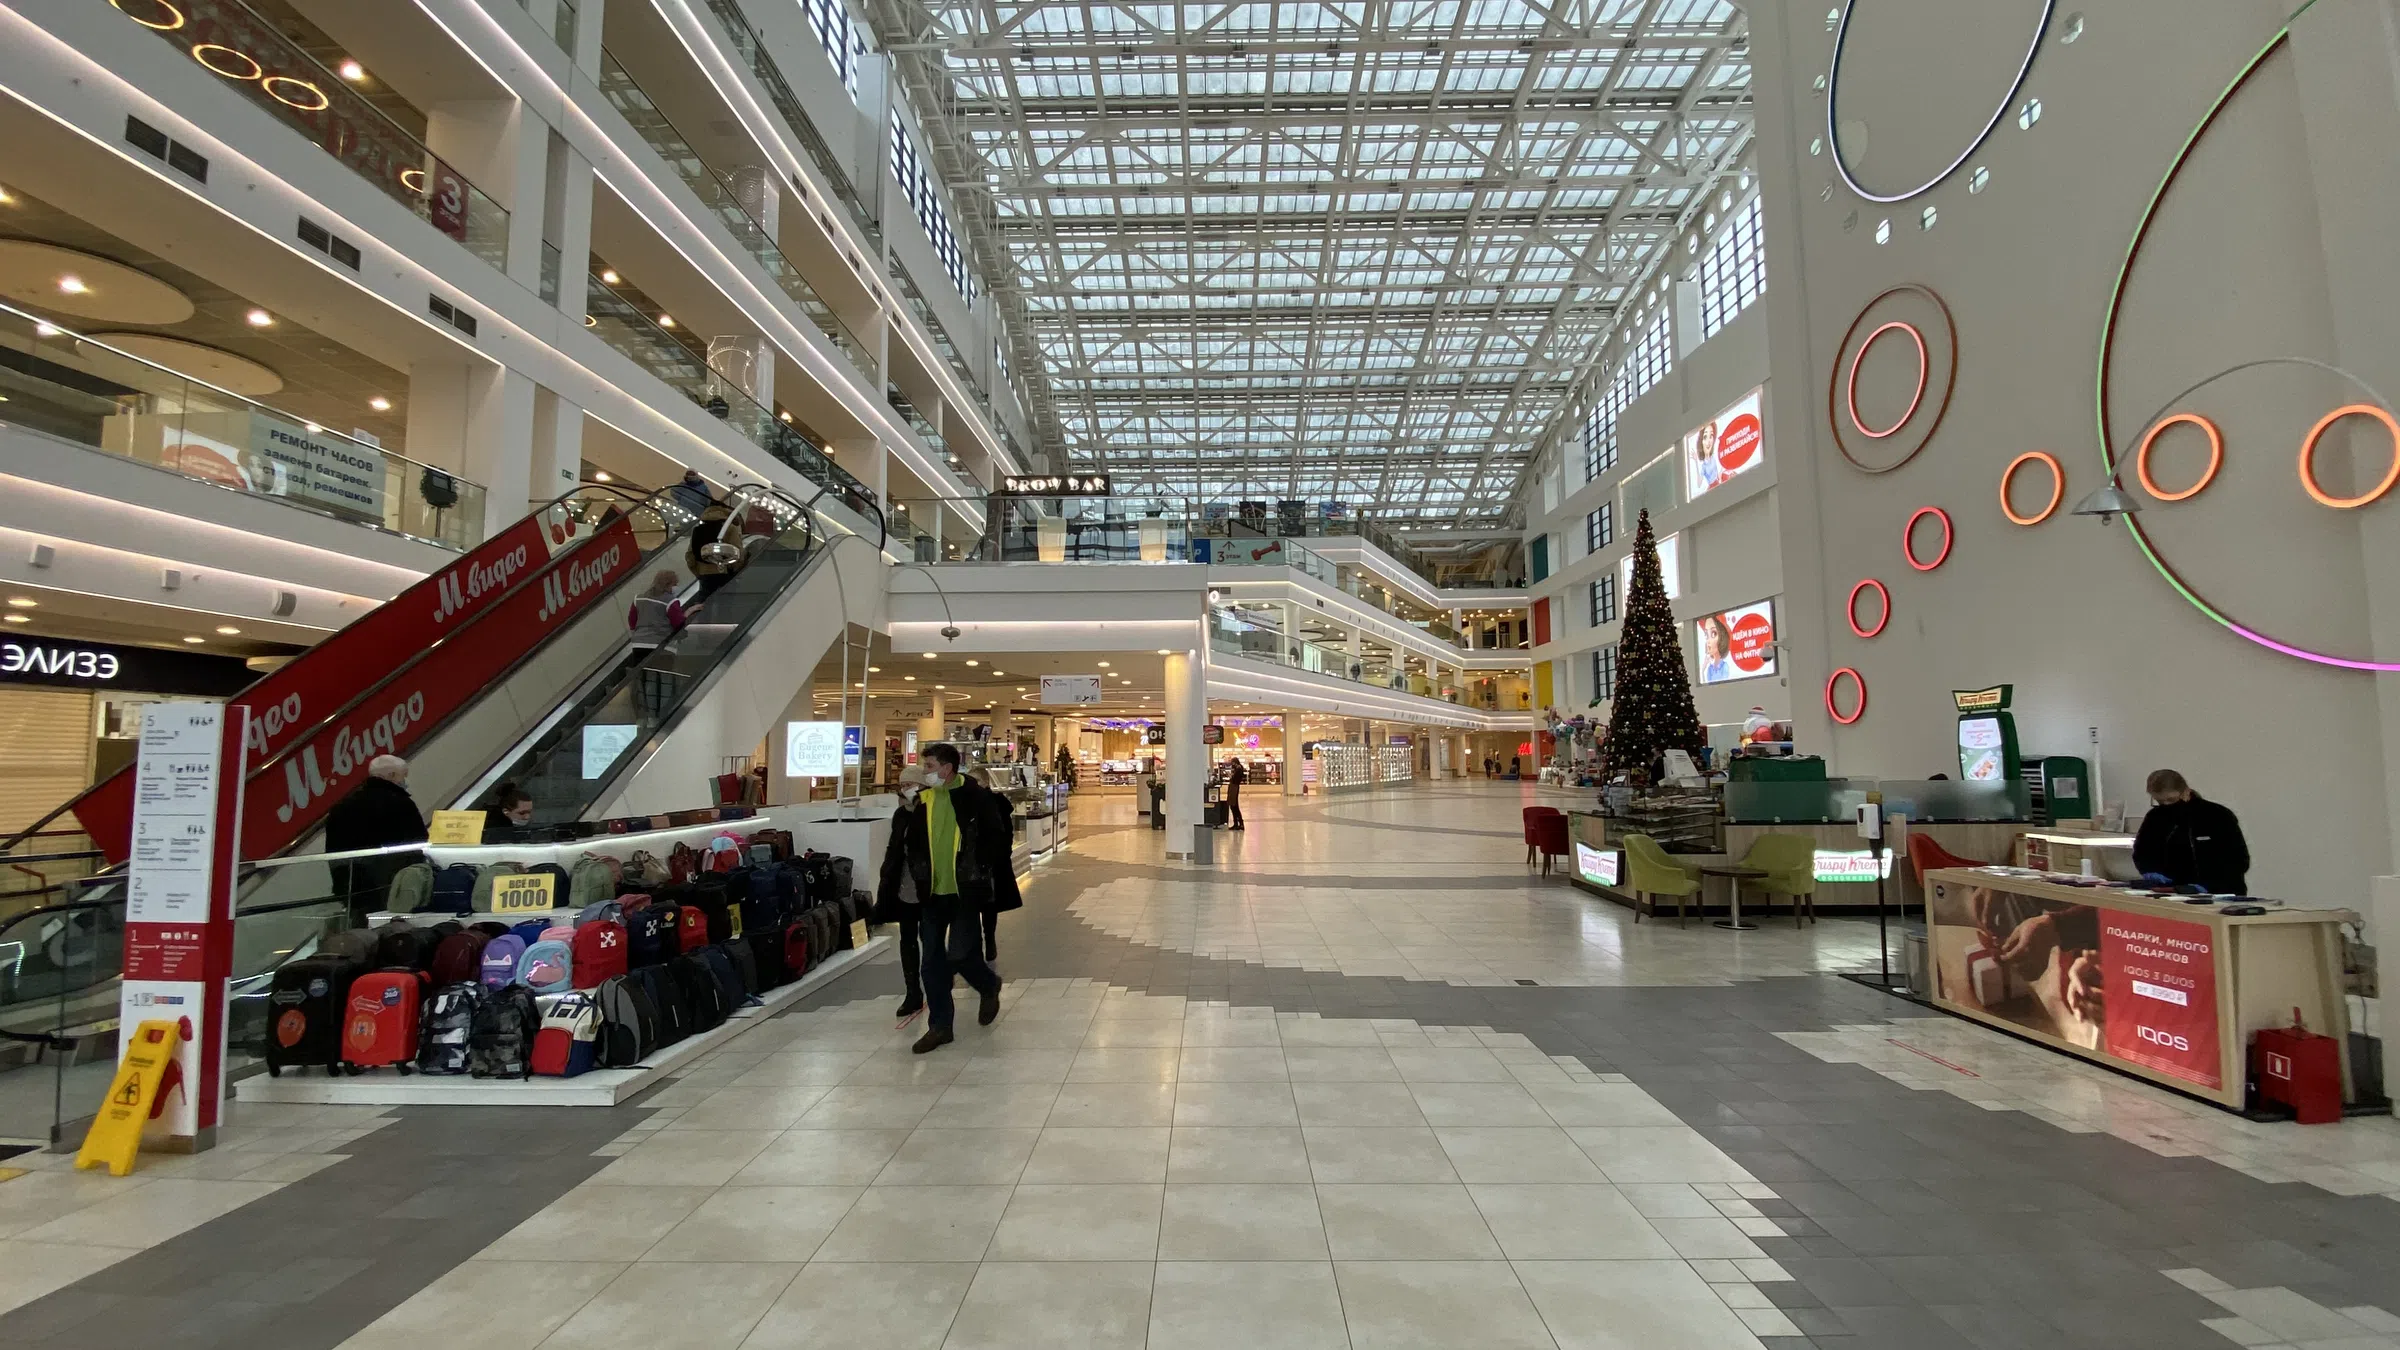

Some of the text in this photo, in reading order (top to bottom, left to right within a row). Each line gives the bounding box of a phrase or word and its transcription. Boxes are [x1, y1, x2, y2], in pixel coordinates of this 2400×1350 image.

[441, 176, 462, 214] 3
[263, 448, 313, 470] замена
[270, 429, 374, 472] РЕМОНТ ЧАСОВ
[262, 465, 311, 488] стол,
[314, 481, 373, 505] ремешков
[1005, 477, 1106, 491] BROW BAR
[1217, 551, 1225, 563] 3
[434, 544, 527, 623] М.видео
[538, 544, 620, 622] М.видео
[1, 643, 119, 680] ЭЛИЗЭ
[147, 714, 155, 727] 5
[276, 690, 424, 823] М.видео
[798, 751, 833, 761] Bakery
[799, 743, 834, 752] Eugene
[143, 761, 151, 773] 4
[138, 823, 147, 835] 3
[1814, 858, 1847, 874] rispy
[134, 877, 143, 890] 2
[528, 878, 541, 888] ПО
[499, 888, 548, 909] 1000
[131, 929, 138, 942] 1
[2126, 943, 2189, 964] ПОДАРКОВ
[2166, 938, 2209, 954] МНОГО
[2123, 965, 2195, 989] IQOS 3 DUOS
[2137, 1025, 2189, 1052] IQOS
